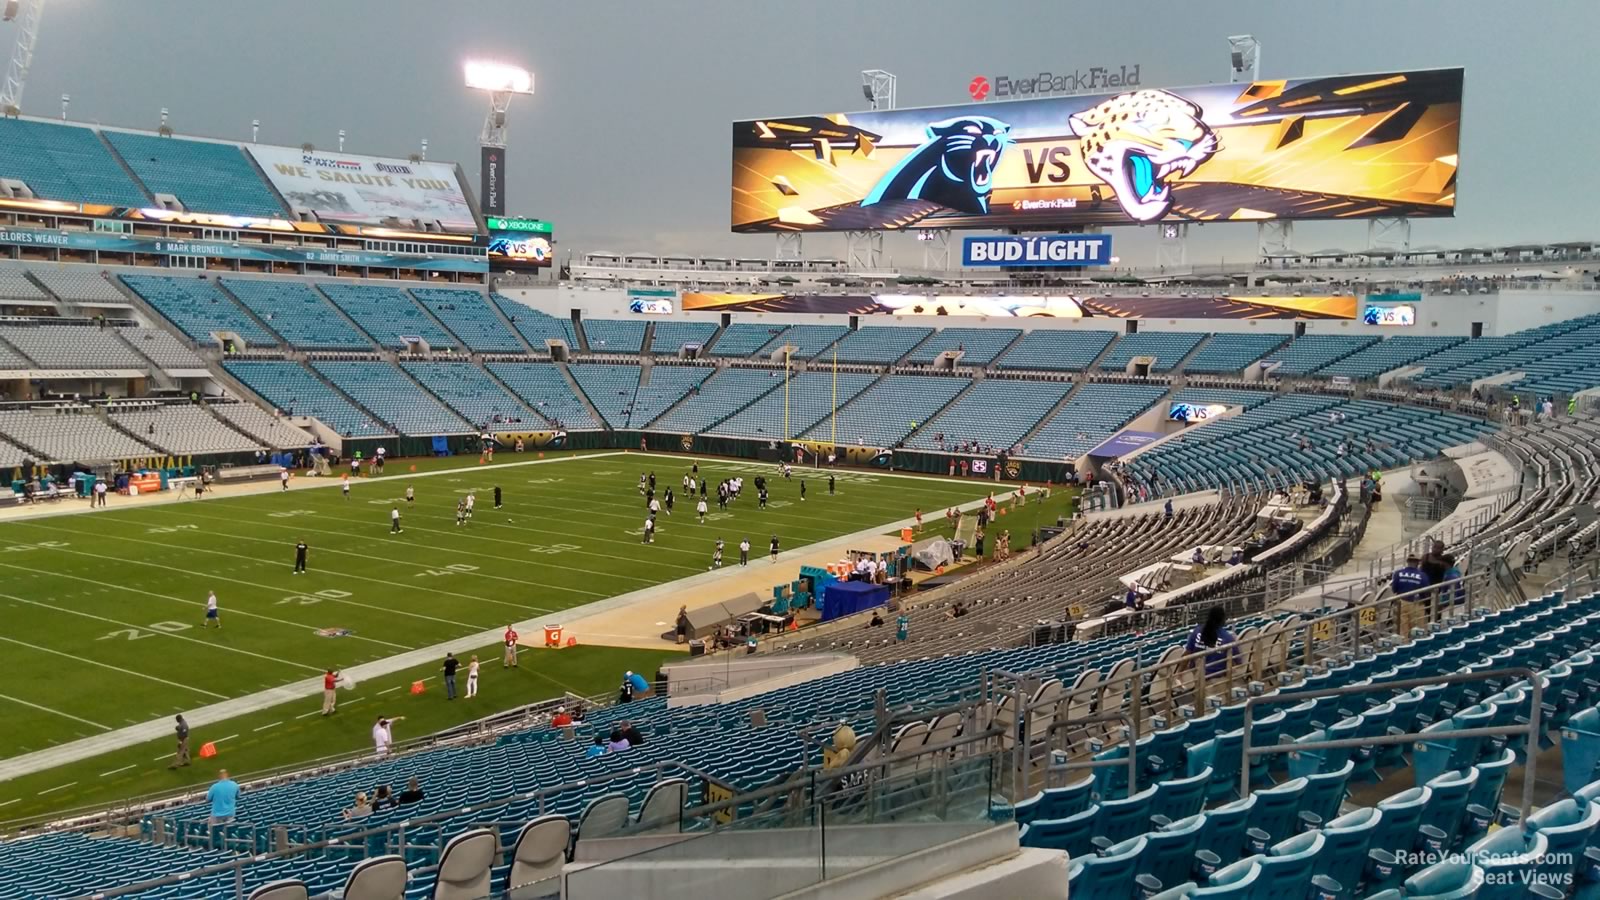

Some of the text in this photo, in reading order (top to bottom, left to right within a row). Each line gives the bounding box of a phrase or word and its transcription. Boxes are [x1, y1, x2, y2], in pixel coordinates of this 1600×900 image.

[1023, 146, 1071, 184] VS
[273, 163, 311, 179] WE
[316, 169, 397, 187] SALUTE
[35, 234, 68, 245] WEAVER
[155, 242, 161, 250] 8
[167, 244, 189, 253] MARK
[191, 245, 224, 254] BRUNELL
[513, 244, 527, 254] VS
[970, 240, 1103, 261] BUD LIGHT
[341, 254, 360, 262] SMITH
[1384, 312, 1395, 321] VS
[1194, 408, 1207, 419] VS
[107, 620, 194, 641] 20
[550, 632, 559, 640] G
